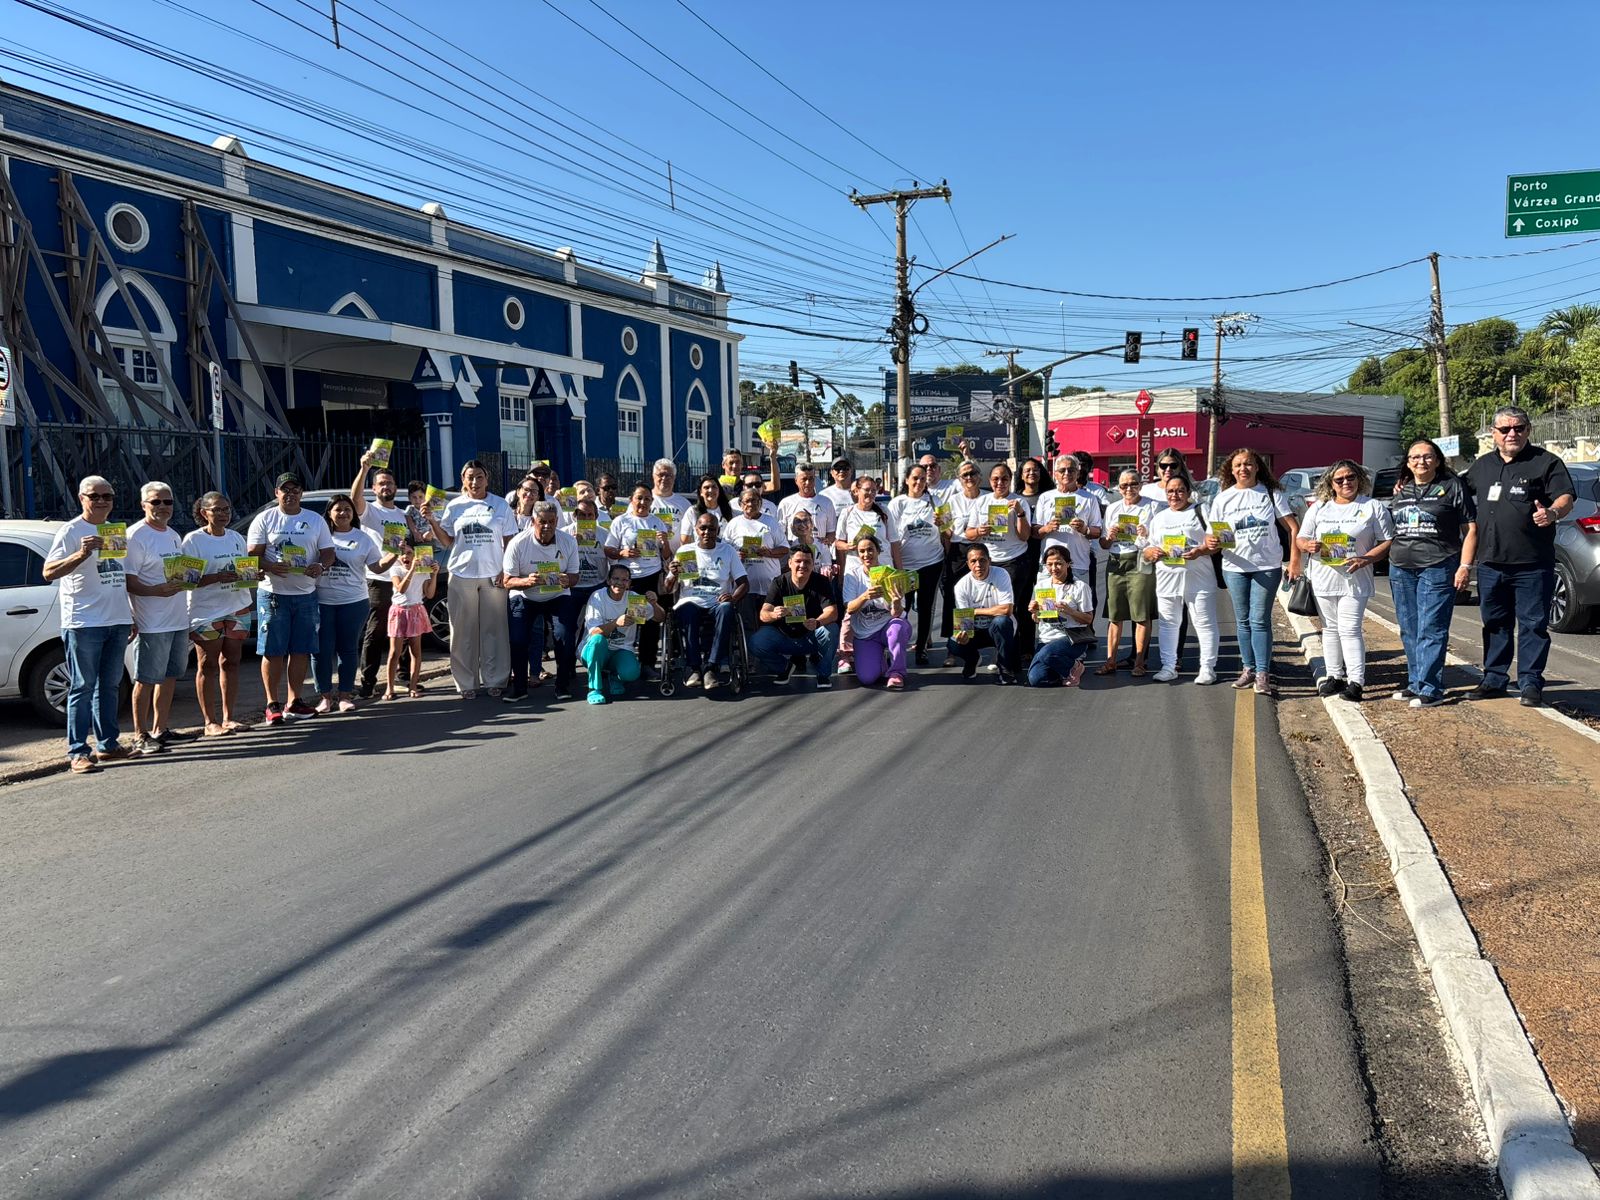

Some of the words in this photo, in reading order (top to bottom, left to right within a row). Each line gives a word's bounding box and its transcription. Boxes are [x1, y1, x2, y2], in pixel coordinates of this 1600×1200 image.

[1513, 181, 1548, 192] Porto
[1513, 197, 1557, 208] Várzea
[1535, 214, 1579, 228] Coxipó
[1126, 427, 1188, 438] DGASIL
